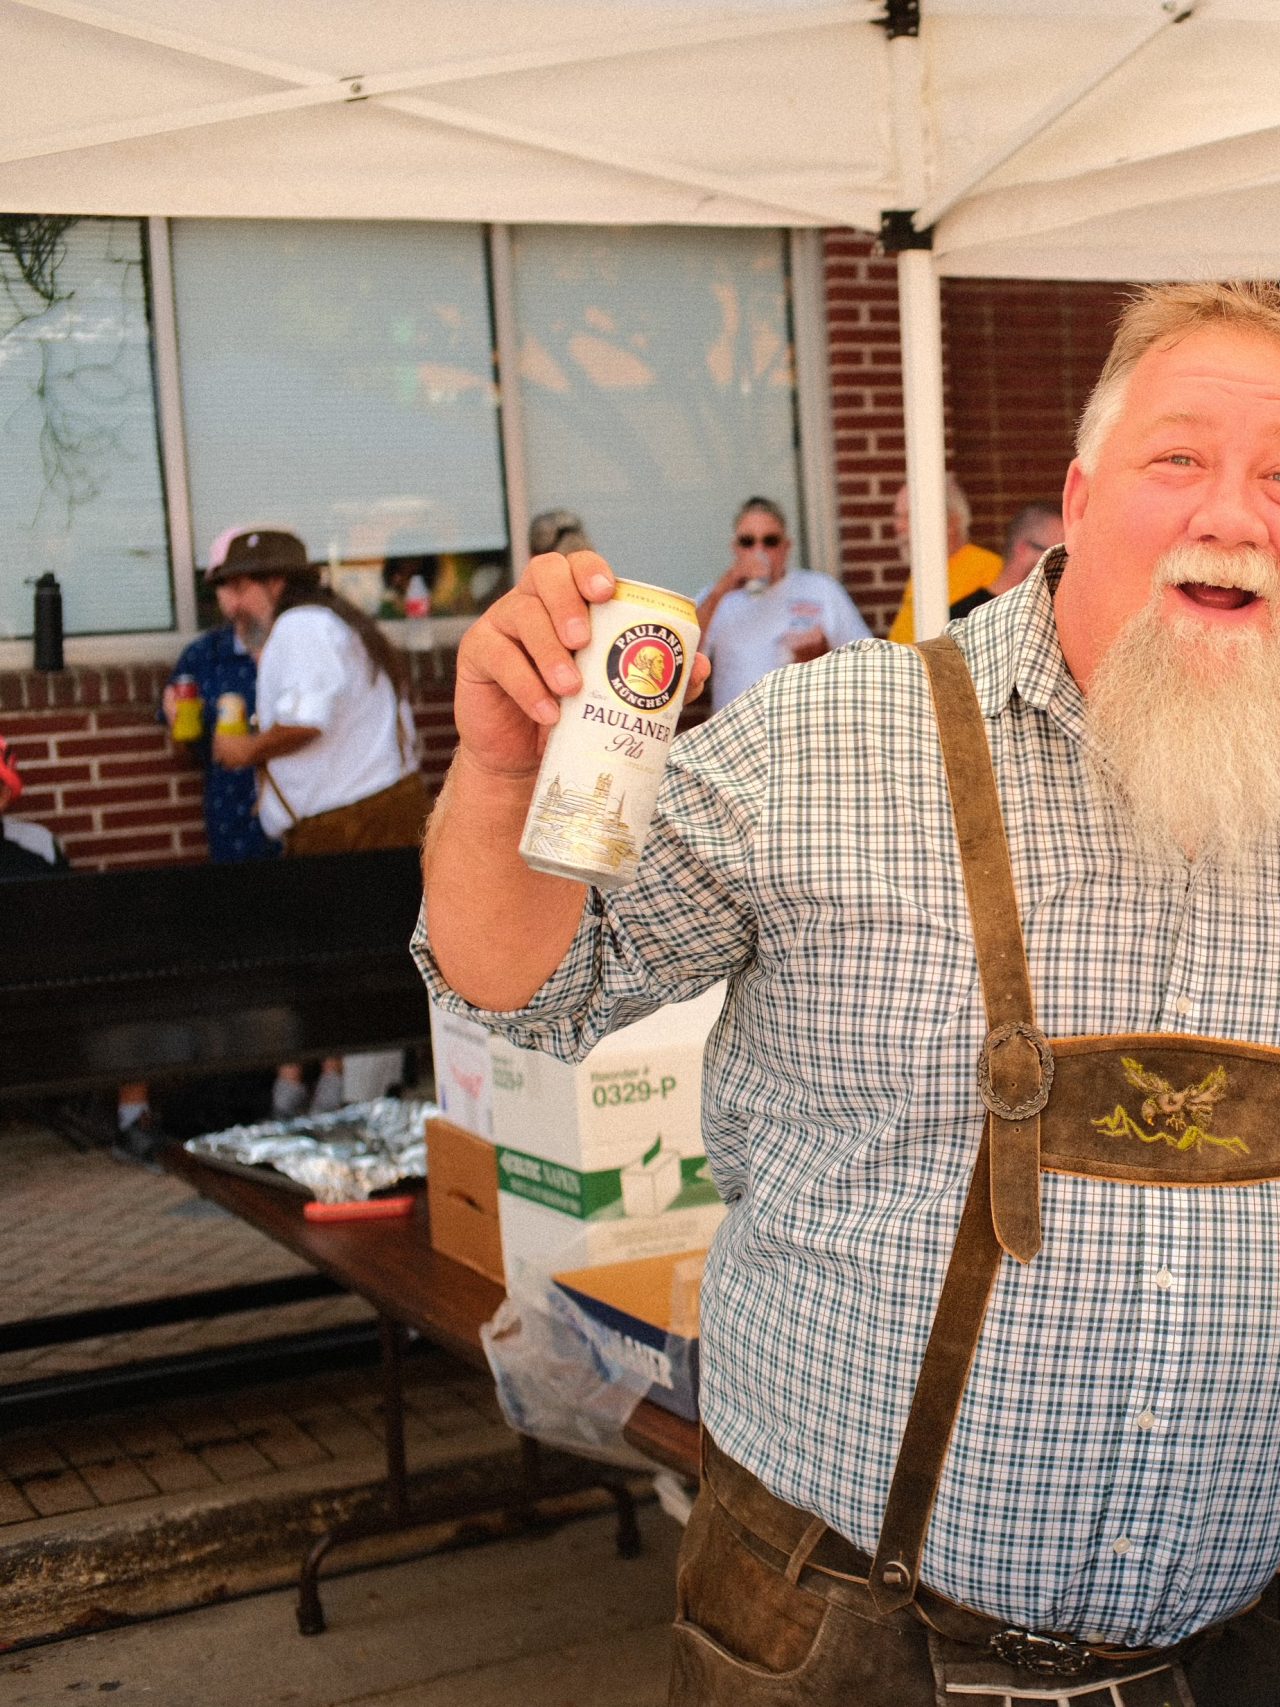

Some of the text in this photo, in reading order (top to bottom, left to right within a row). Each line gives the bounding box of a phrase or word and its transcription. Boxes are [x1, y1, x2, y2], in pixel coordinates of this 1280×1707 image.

[615, 625, 683, 666] PAULANER
[582, 703, 671, 743] PAULANER
[604, 733, 644, 759] Pils
[592, 1076, 677, 1108] 0329-P
